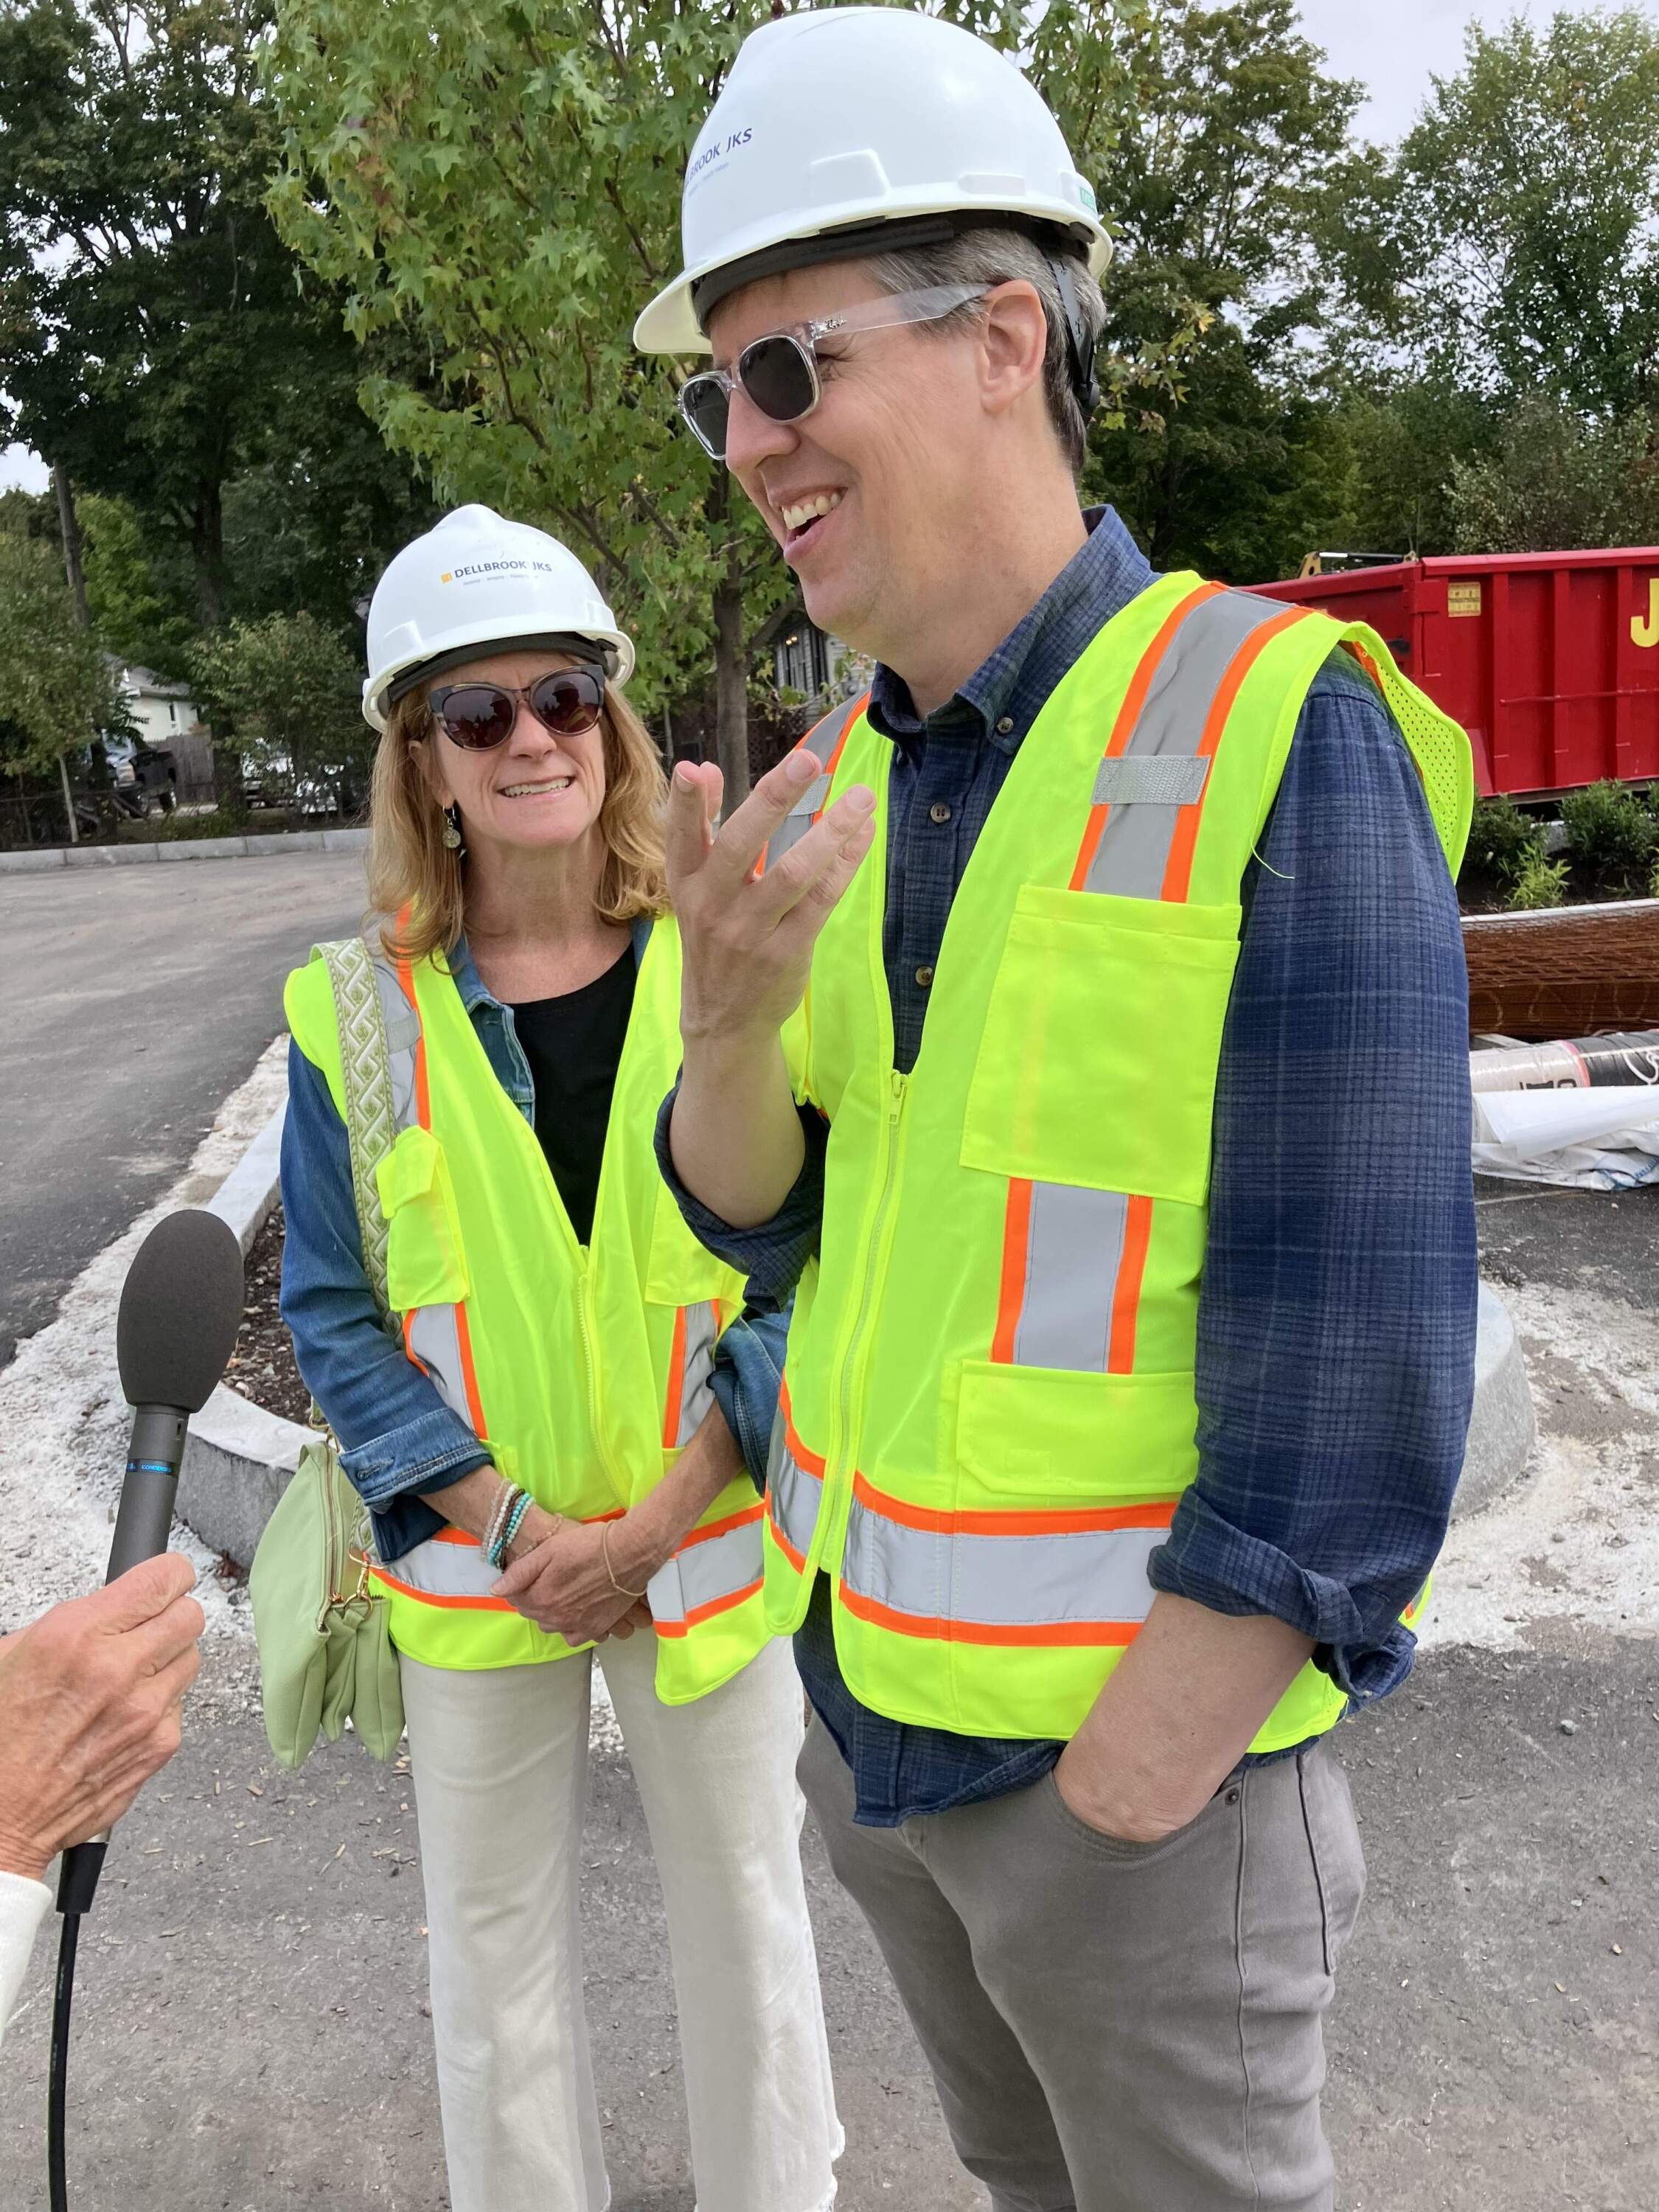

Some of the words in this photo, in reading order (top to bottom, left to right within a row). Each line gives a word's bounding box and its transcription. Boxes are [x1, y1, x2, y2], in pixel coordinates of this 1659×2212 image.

[686, 142, 720, 184] BROOK
[726, 128, 752, 153] JKS
[454, 560, 527, 578] DELLBROOK
[532, 561, 552, 572] JKS
